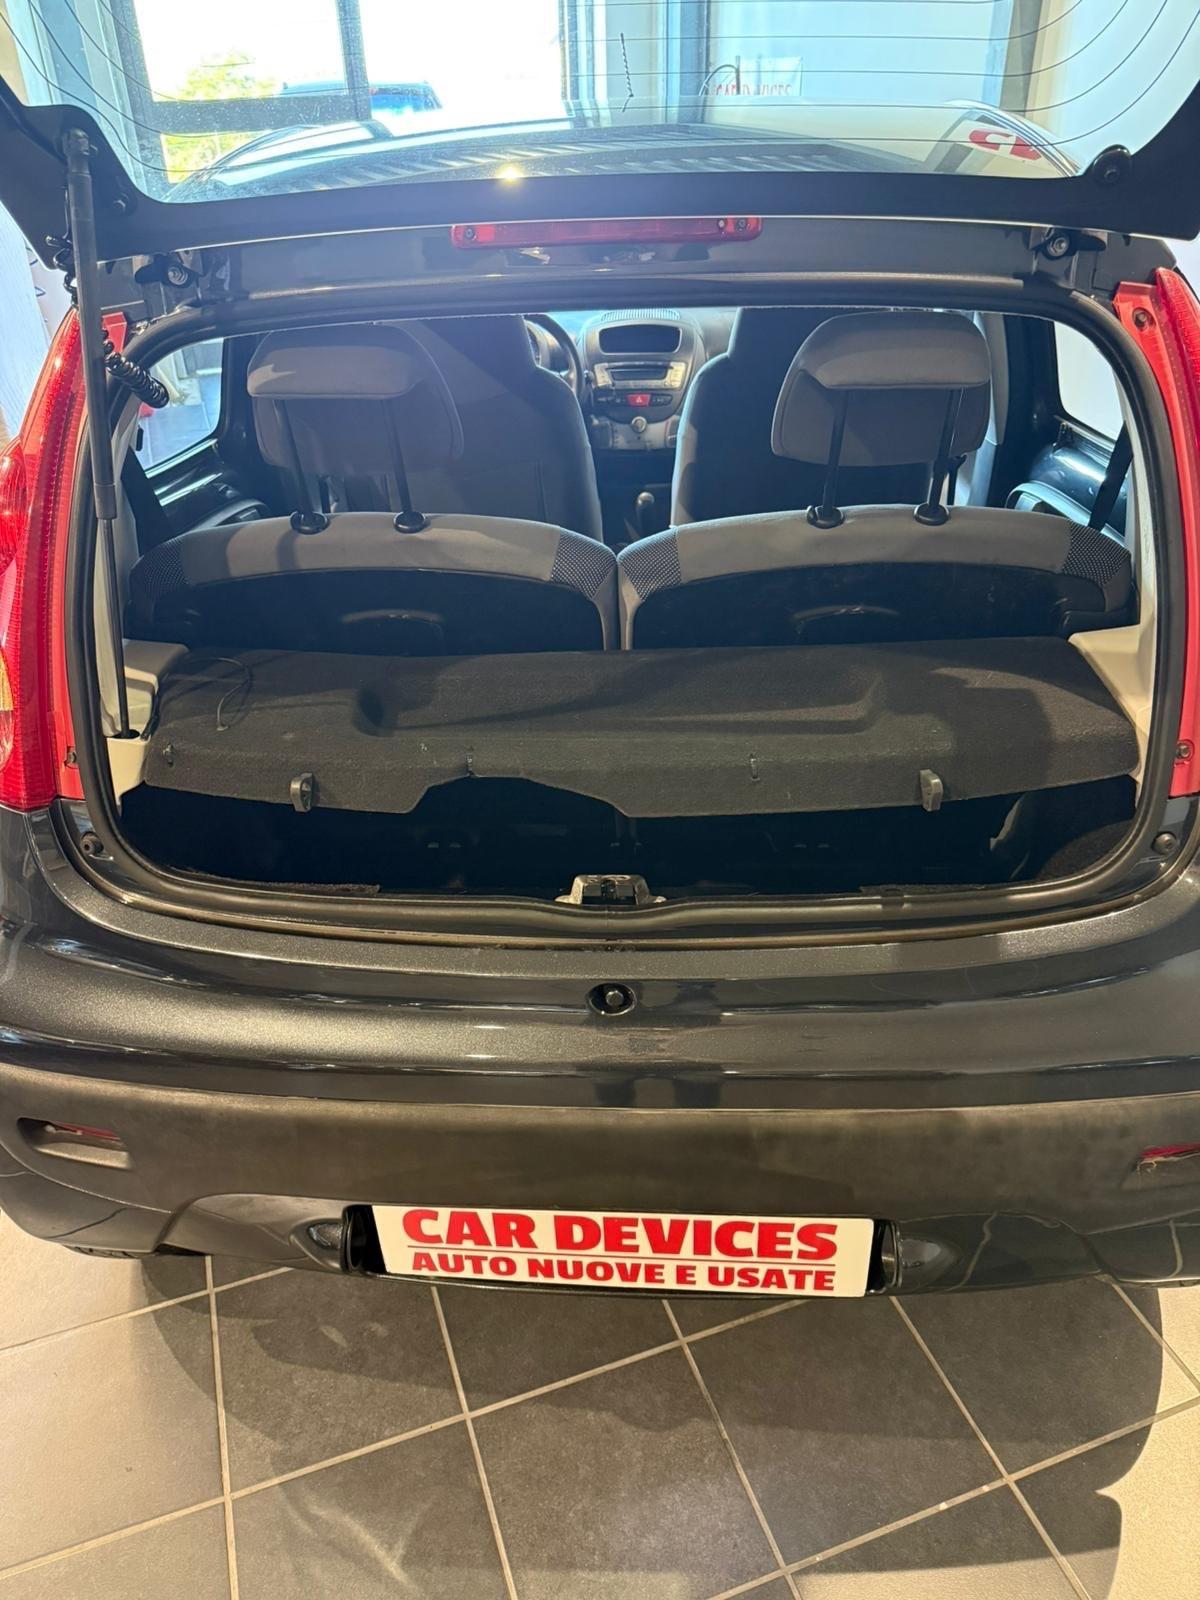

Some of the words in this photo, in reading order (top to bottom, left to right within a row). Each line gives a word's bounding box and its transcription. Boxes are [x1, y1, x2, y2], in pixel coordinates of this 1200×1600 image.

[401, 1208, 537, 1250] CAR
[553, 1214, 838, 1262] DEVICES
[412, 1251, 518, 1277] AUTO
[526, 1258, 665, 1285] NUOVE
[675, 1264, 696, 1286] E
[707, 1265, 835, 1292] USATE
